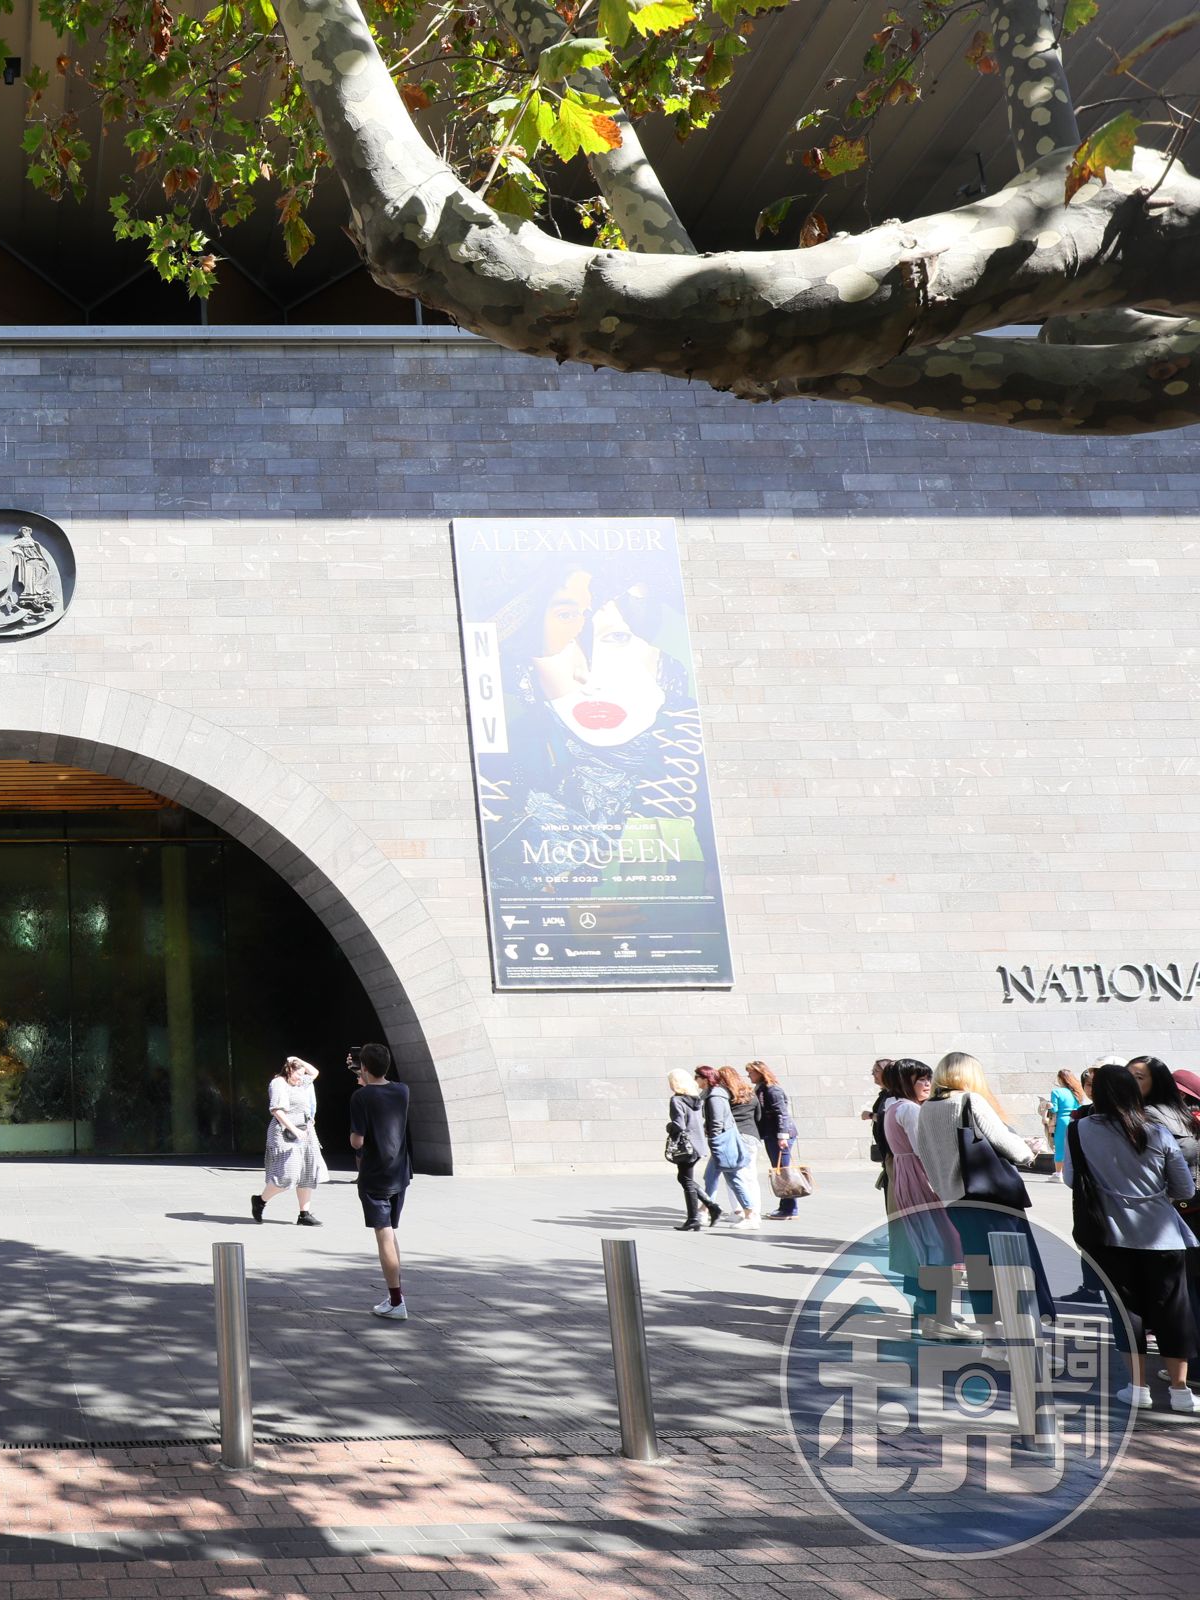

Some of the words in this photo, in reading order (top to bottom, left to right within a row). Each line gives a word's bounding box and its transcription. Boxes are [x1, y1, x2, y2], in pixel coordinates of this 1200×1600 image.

[469, 528, 668, 551] ALEXANDER
[573, 824, 622, 832] MYTHOS
[625, 823, 657, 831] MUSE
[520, 838, 681, 869] McQUEEN
